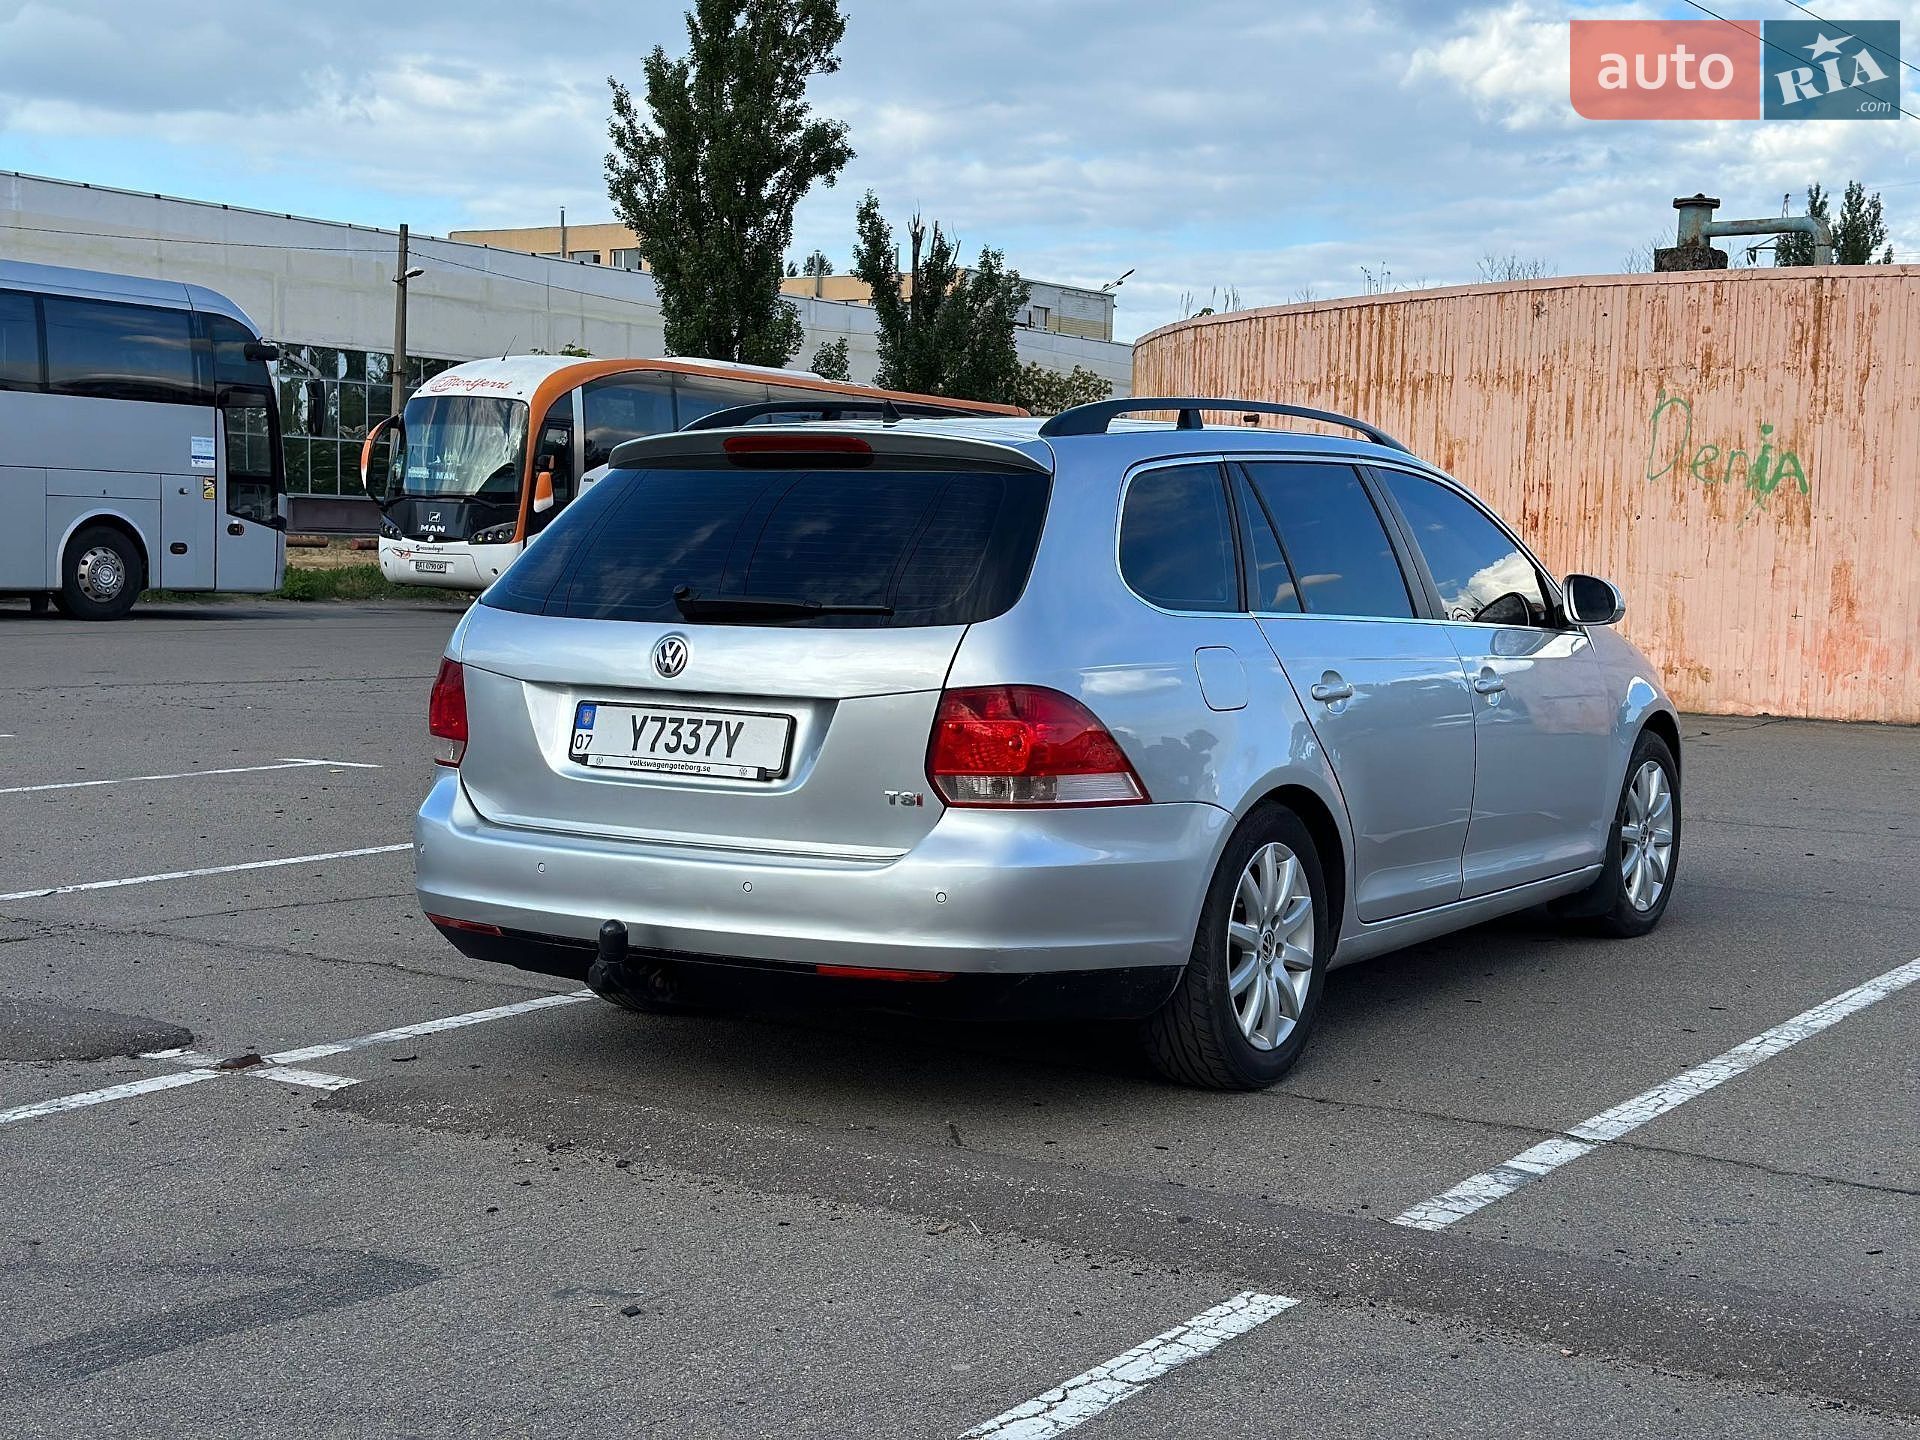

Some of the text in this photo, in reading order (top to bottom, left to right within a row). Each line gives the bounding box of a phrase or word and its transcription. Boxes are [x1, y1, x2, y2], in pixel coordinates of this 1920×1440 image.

[420, 524, 446, 533] MAN
[574, 733, 593, 750] 07
[631, 714, 745, 759] Y7337Y
[629, 759, 711, 774] volkswagengoteborg.se
